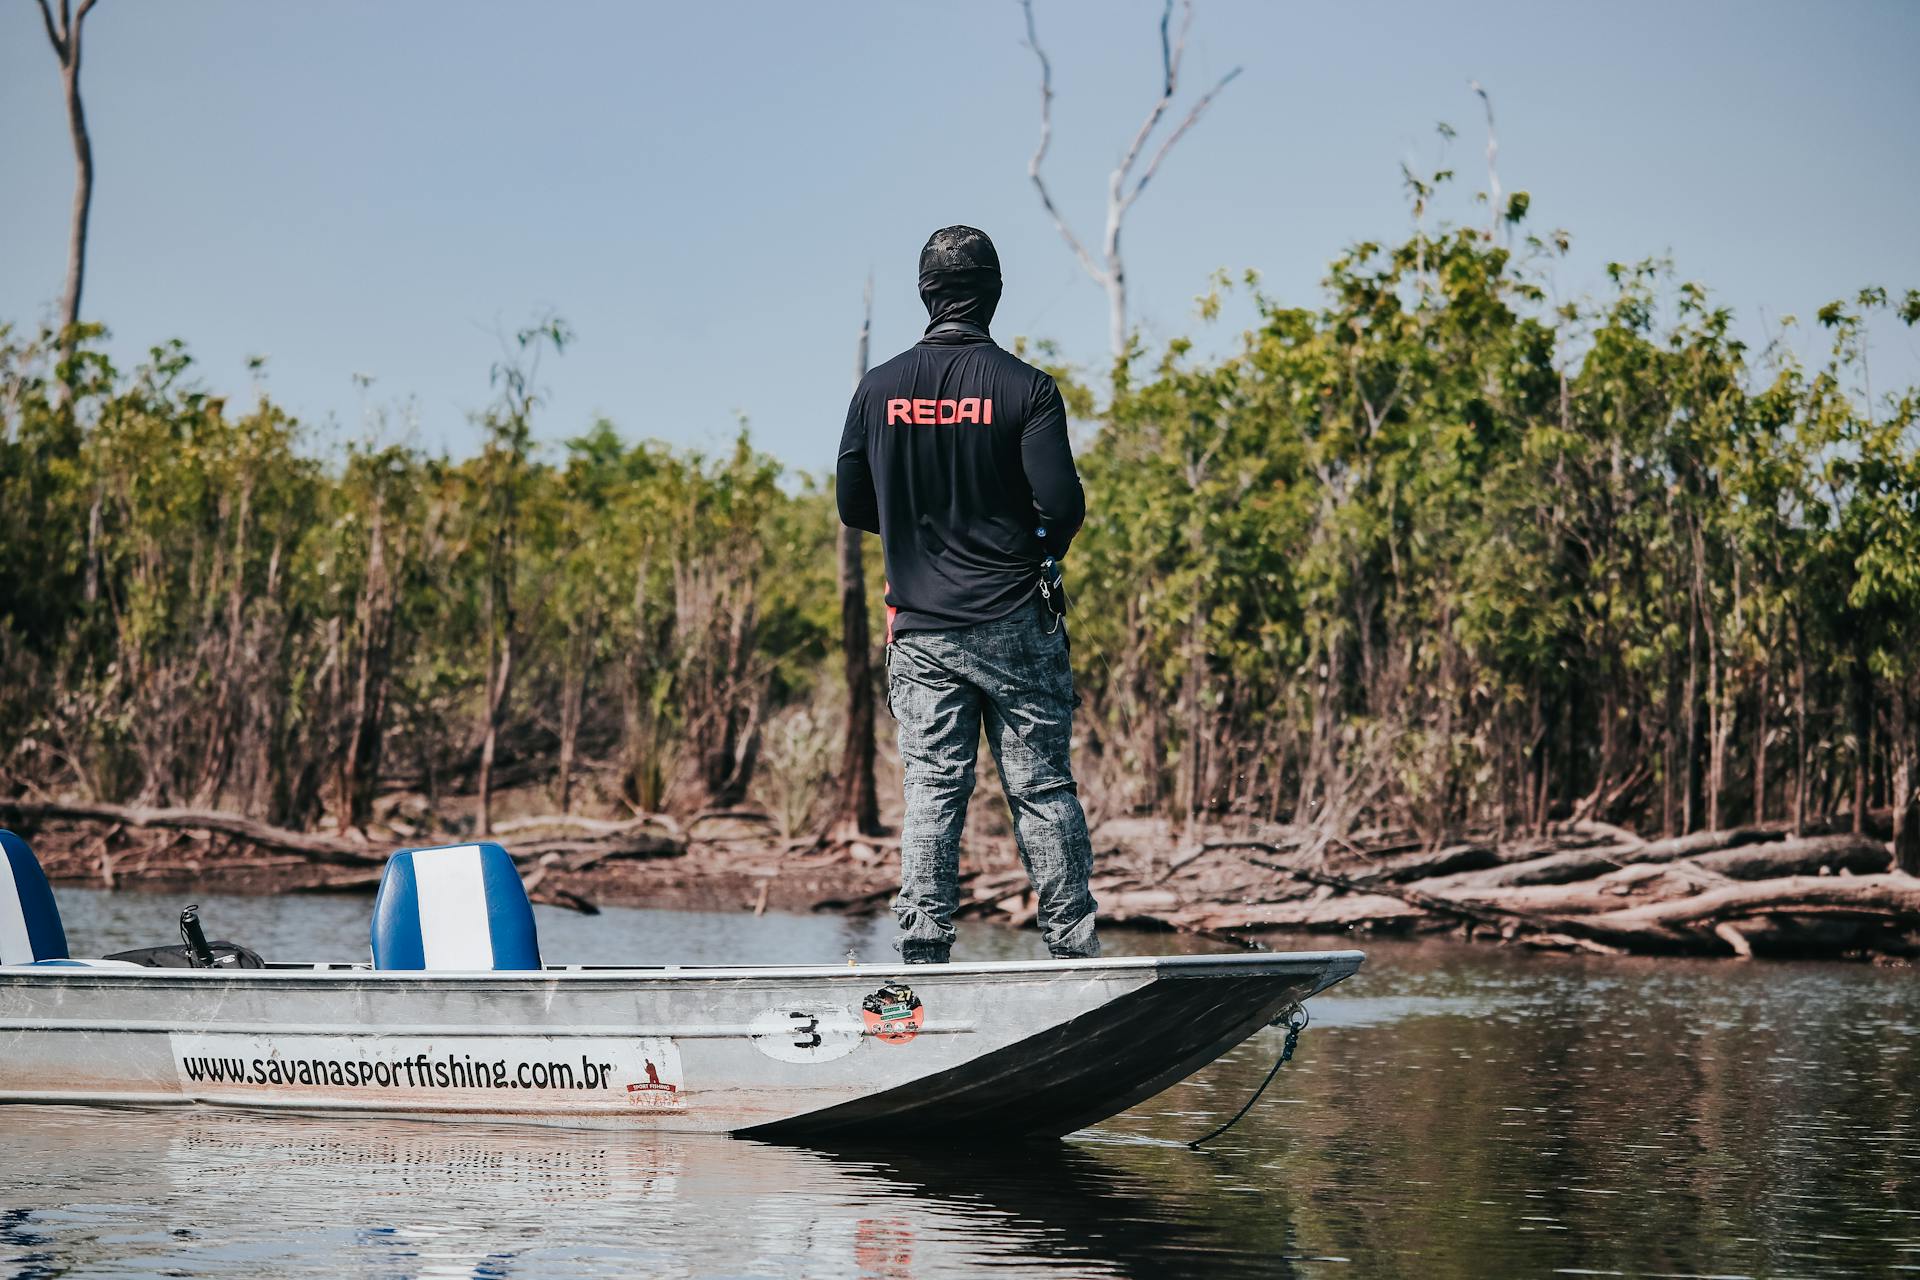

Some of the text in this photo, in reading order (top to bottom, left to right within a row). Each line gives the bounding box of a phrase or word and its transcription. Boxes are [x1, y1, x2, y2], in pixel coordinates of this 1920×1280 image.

[887, 397, 993, 426] REDAI
[896, 990, 912, 1001] 27
[789, 1011, 822, 1049] 3
[184, 1054, 612, 1090] www.savanasportfishing.com.br
